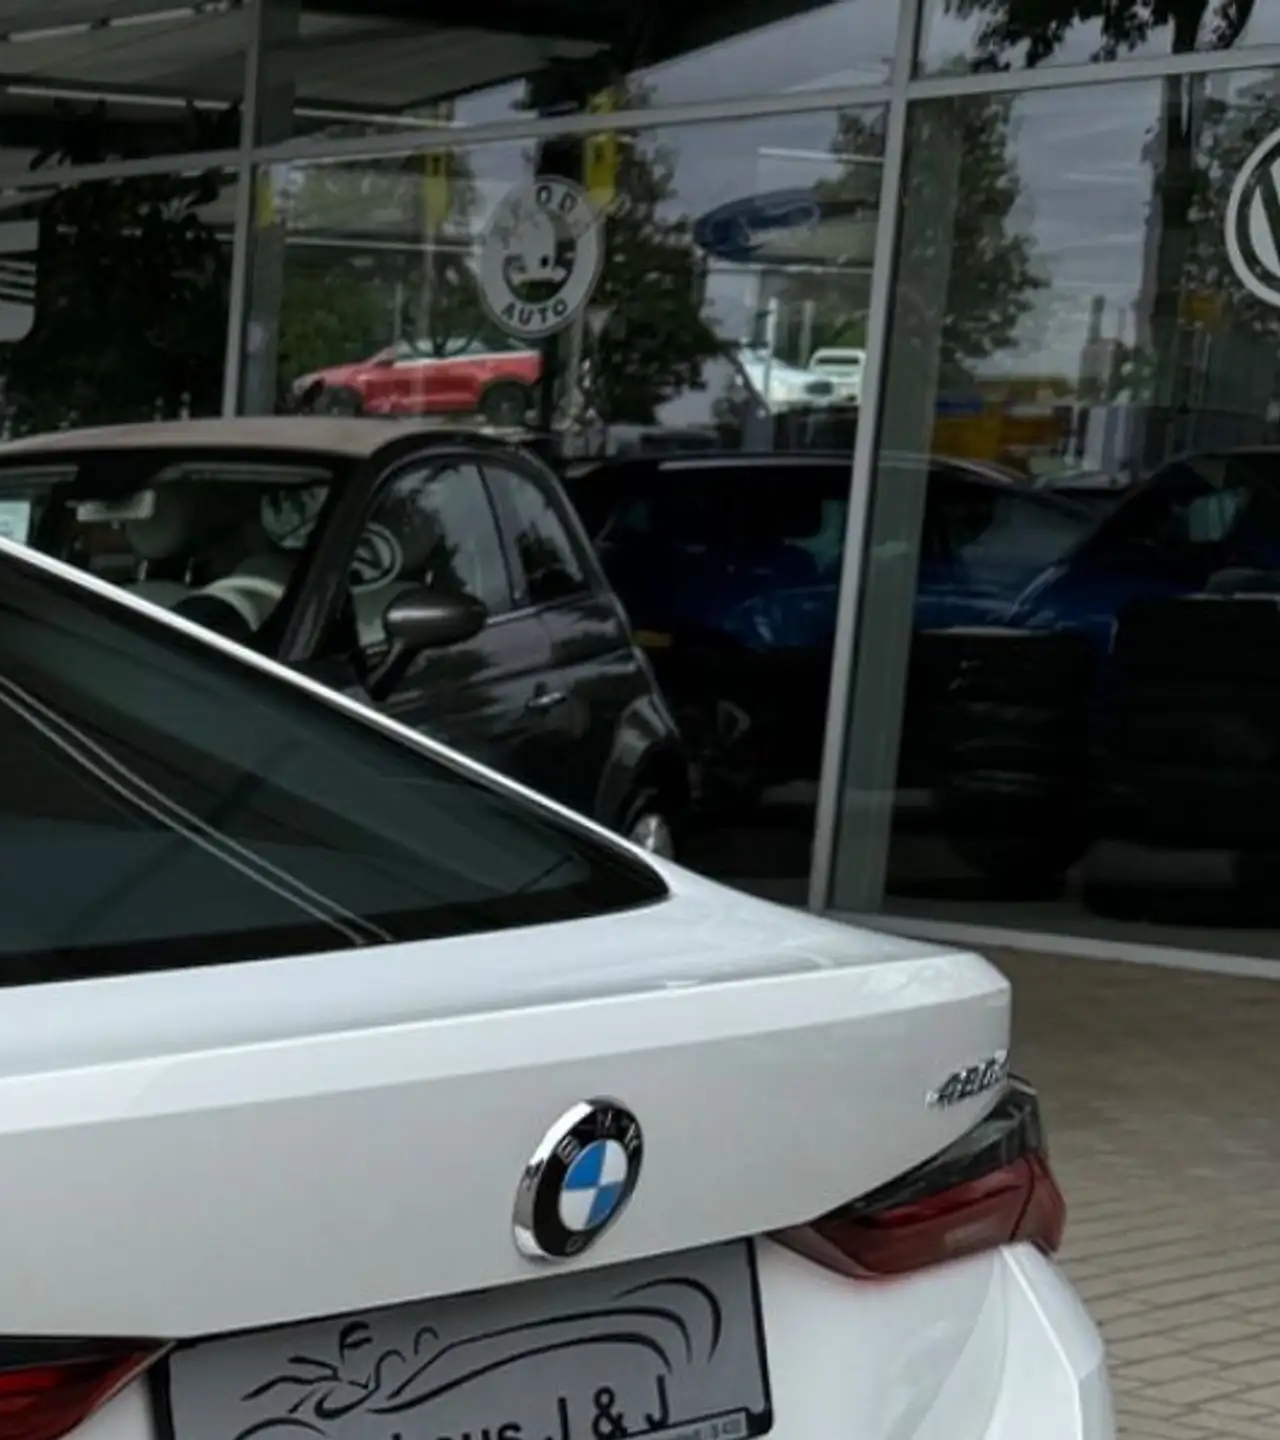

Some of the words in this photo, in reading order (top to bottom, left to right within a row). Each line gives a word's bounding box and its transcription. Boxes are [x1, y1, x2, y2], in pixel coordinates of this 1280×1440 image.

[500, 297, 569, 326] AUTO
[592, 1386, 630, 1440] &
[645, 1374, 671, 1429] J
